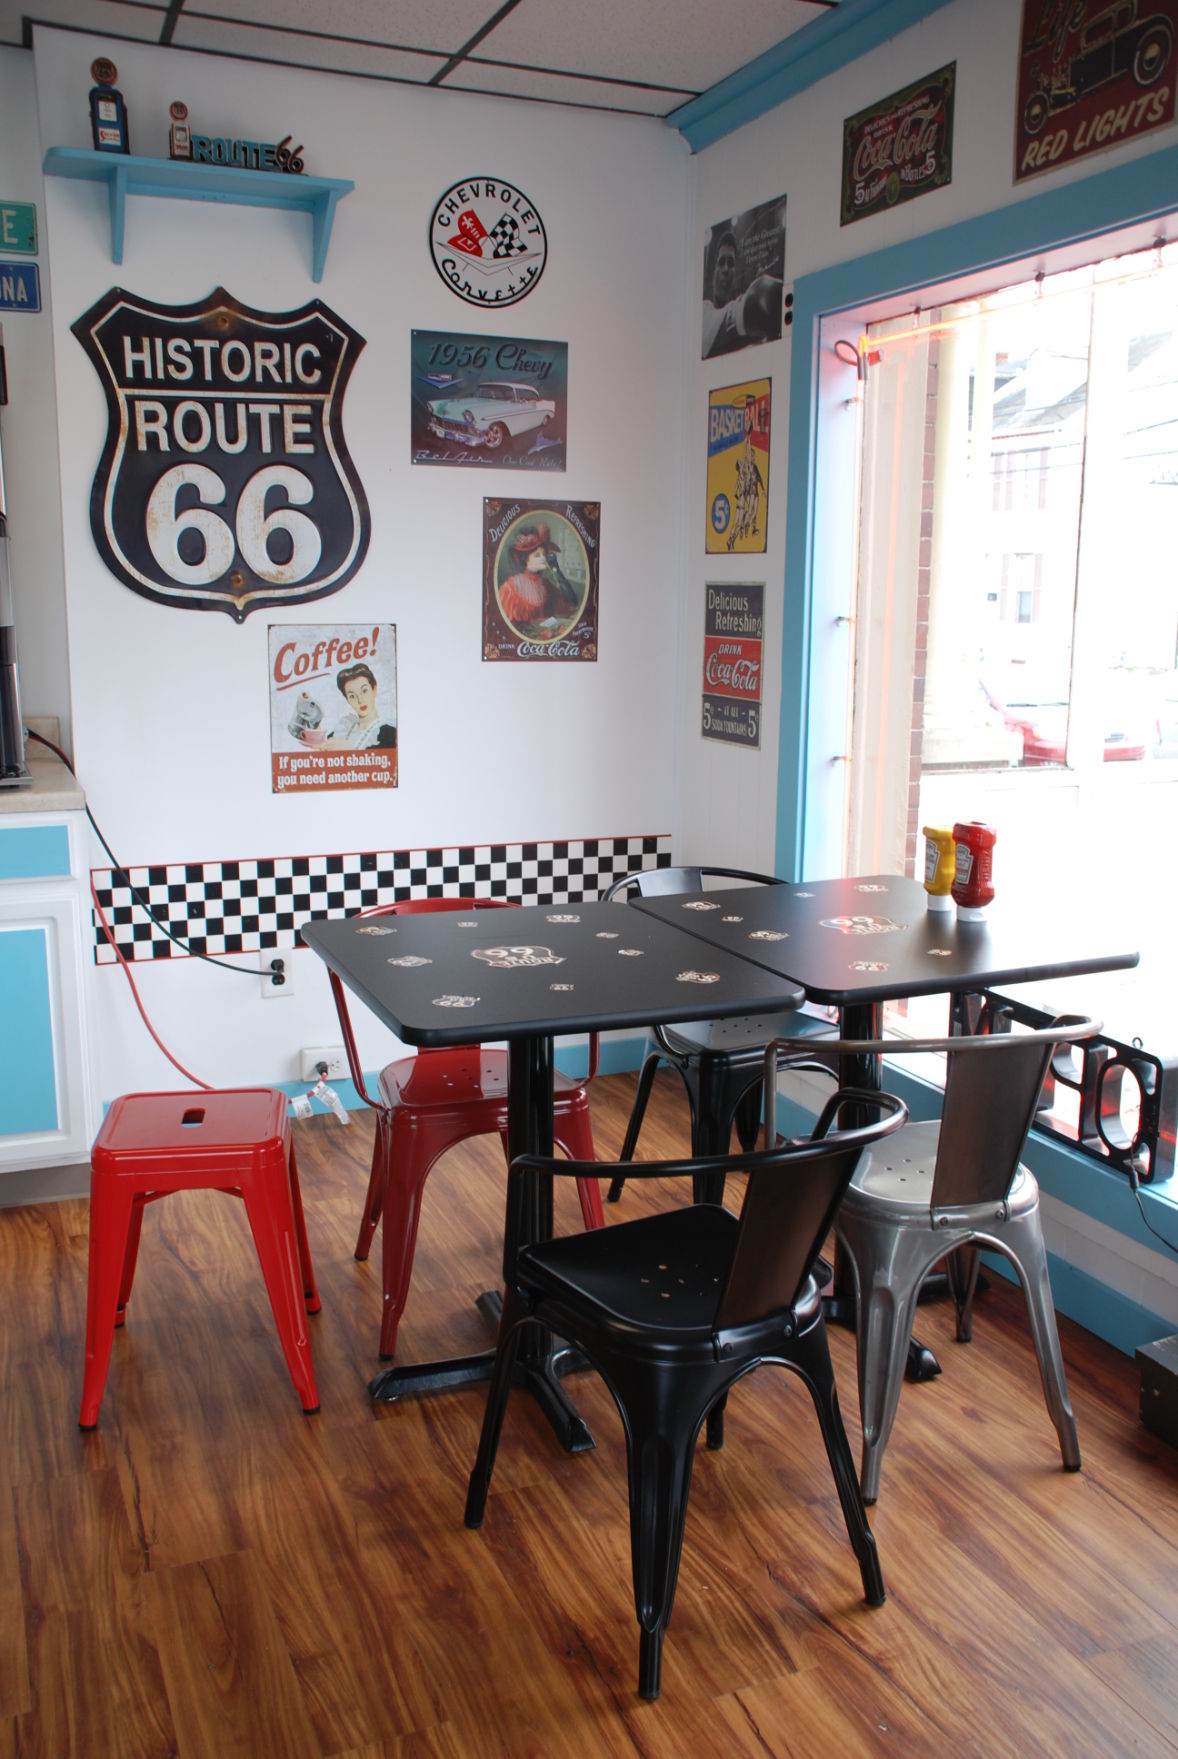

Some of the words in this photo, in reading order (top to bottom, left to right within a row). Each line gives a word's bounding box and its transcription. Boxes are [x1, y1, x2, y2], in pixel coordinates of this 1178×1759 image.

[1021, 129, 1068, 172] RED
[1073, 86, 1170, 153] LIGHTS
[191, 134, 281, 171] ROUTE
[275, 135, 304, 174] 66
[437, 183, 542, 236] CHEVROLET
[0, 276, 28, 302] NA
[441, 257, 539, 304] Corvette
[122, 335, 322, 385] HISTORIC
[429, 343, 491, 370] 1956
[495, 343, 554, 381] Chevy
[134, 400, 316, 454] ROUTE
[145, 463, 322, 586] 66
[708, 589, 749, 612] Delicious
[715, 611, 762, 637] Refreshing
[273, 626, 380, 684] Coffee!
[516, 639, 580, 658] Coca-Cola
[718, 644, 743, 656] DRINK
[705, 652, 760, 691] Coca-Cola
[277, 775, 297, 789] you
[299, 772, 326, 785] need
[327, 770, 370, 784] another
[371, 771, 394, 784] cup.
[279, 755, 289, 769] If
[290, 755, 326, 773] you're
[327, 754, 345, 768] not
[346, 751, 392, 769] shaking,
